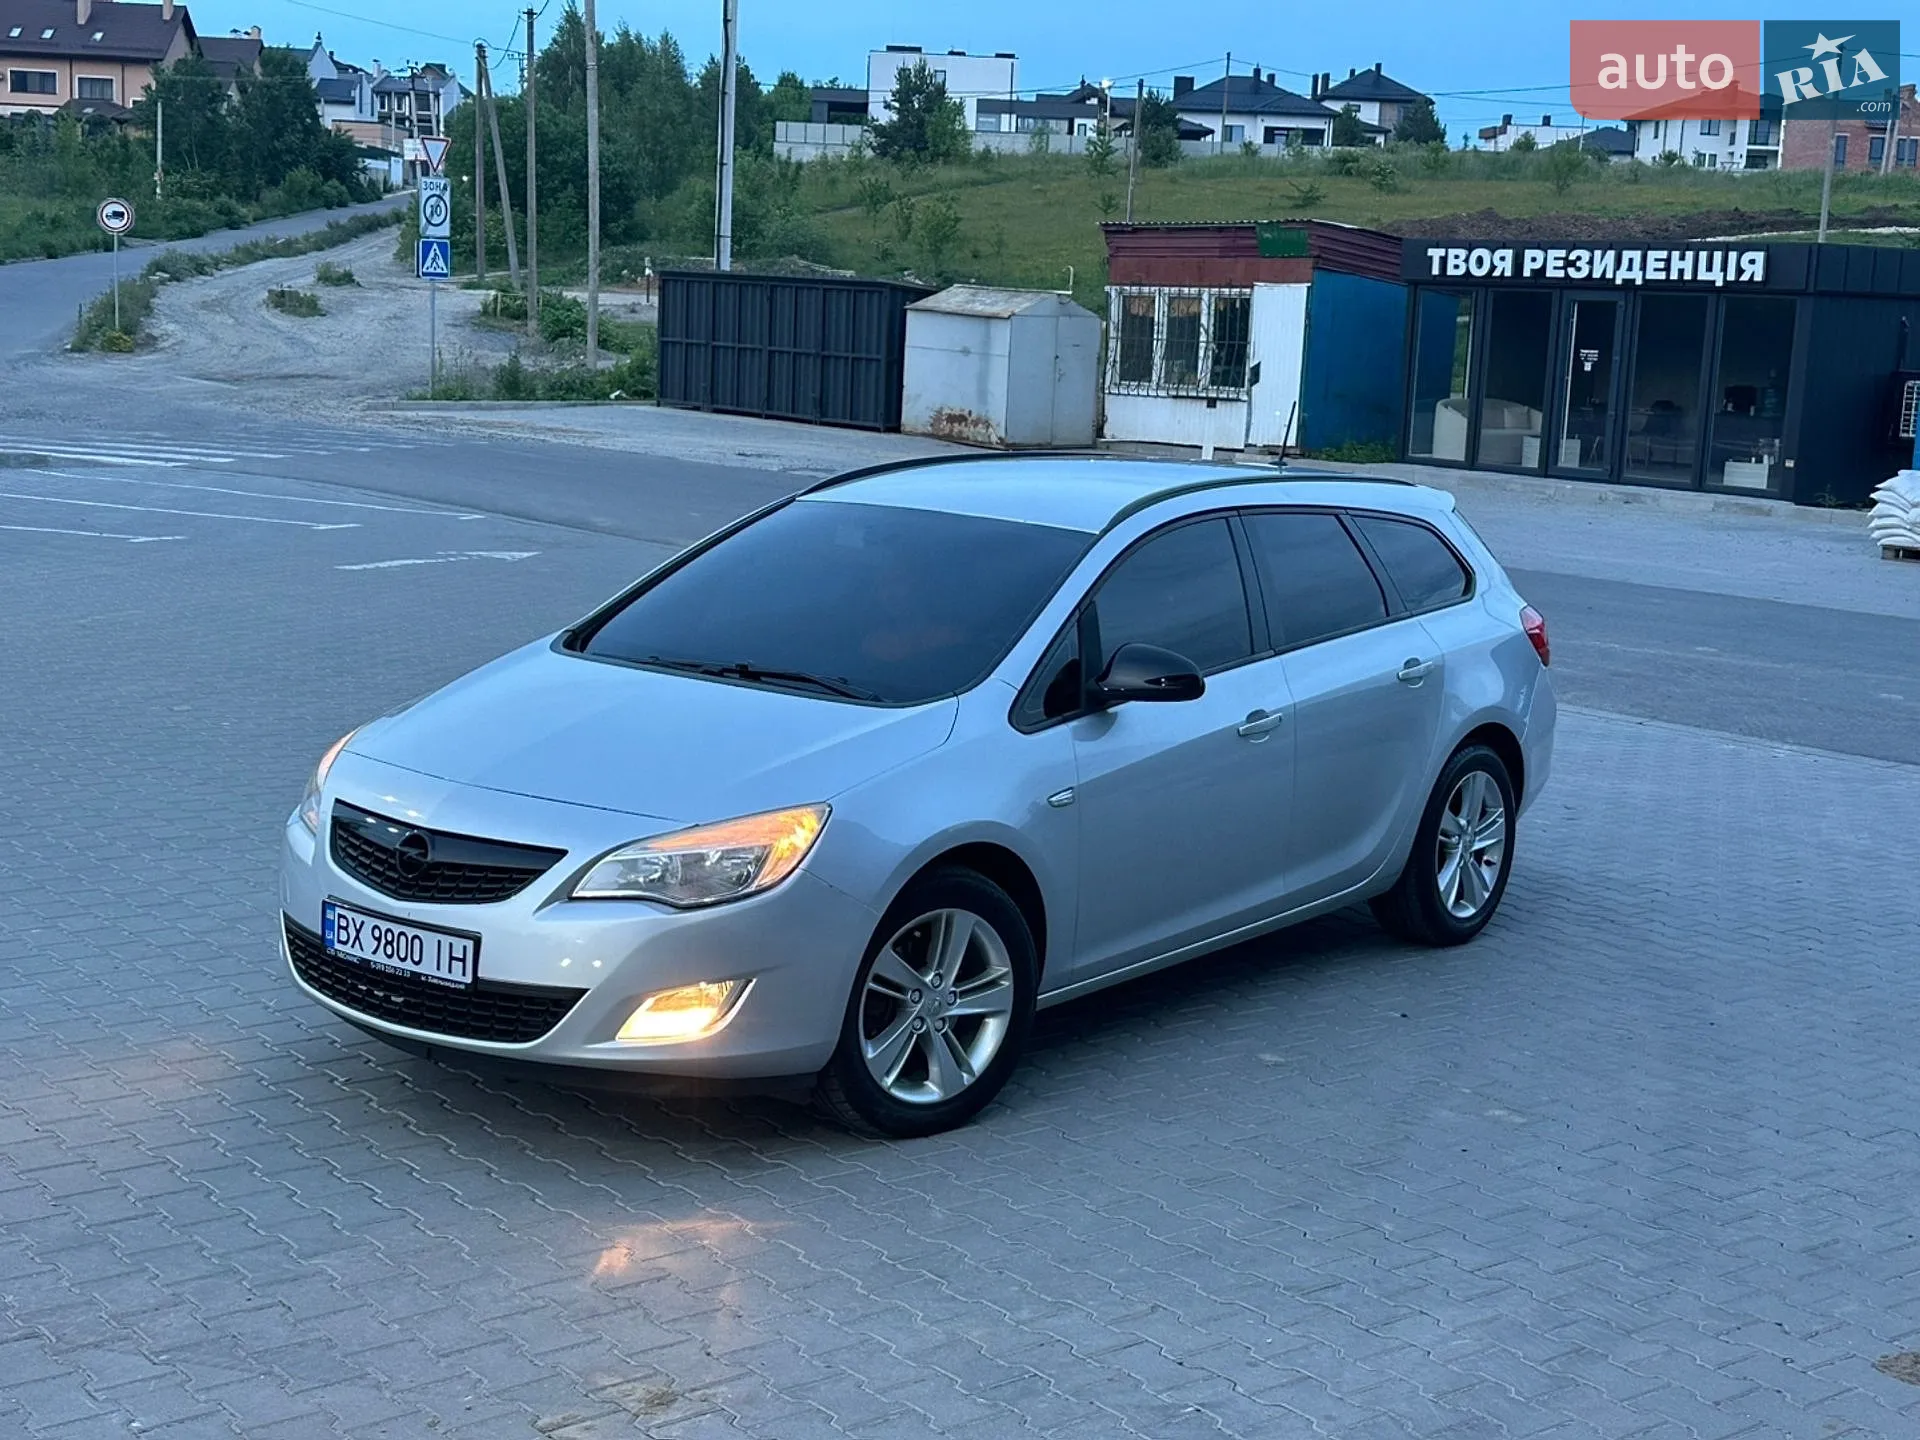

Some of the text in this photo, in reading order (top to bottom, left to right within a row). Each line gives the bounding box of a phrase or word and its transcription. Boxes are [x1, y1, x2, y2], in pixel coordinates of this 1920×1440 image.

[423, 181, 448, 192] ЗОНА
[1427, 247, 1767, 286] ТВОЯ РЕЗИДЕНЦІЯ
[337, 912, 365, 952] BX
[371, 924, 424, 966] 9800
[436, 939, 467, 977] IH
